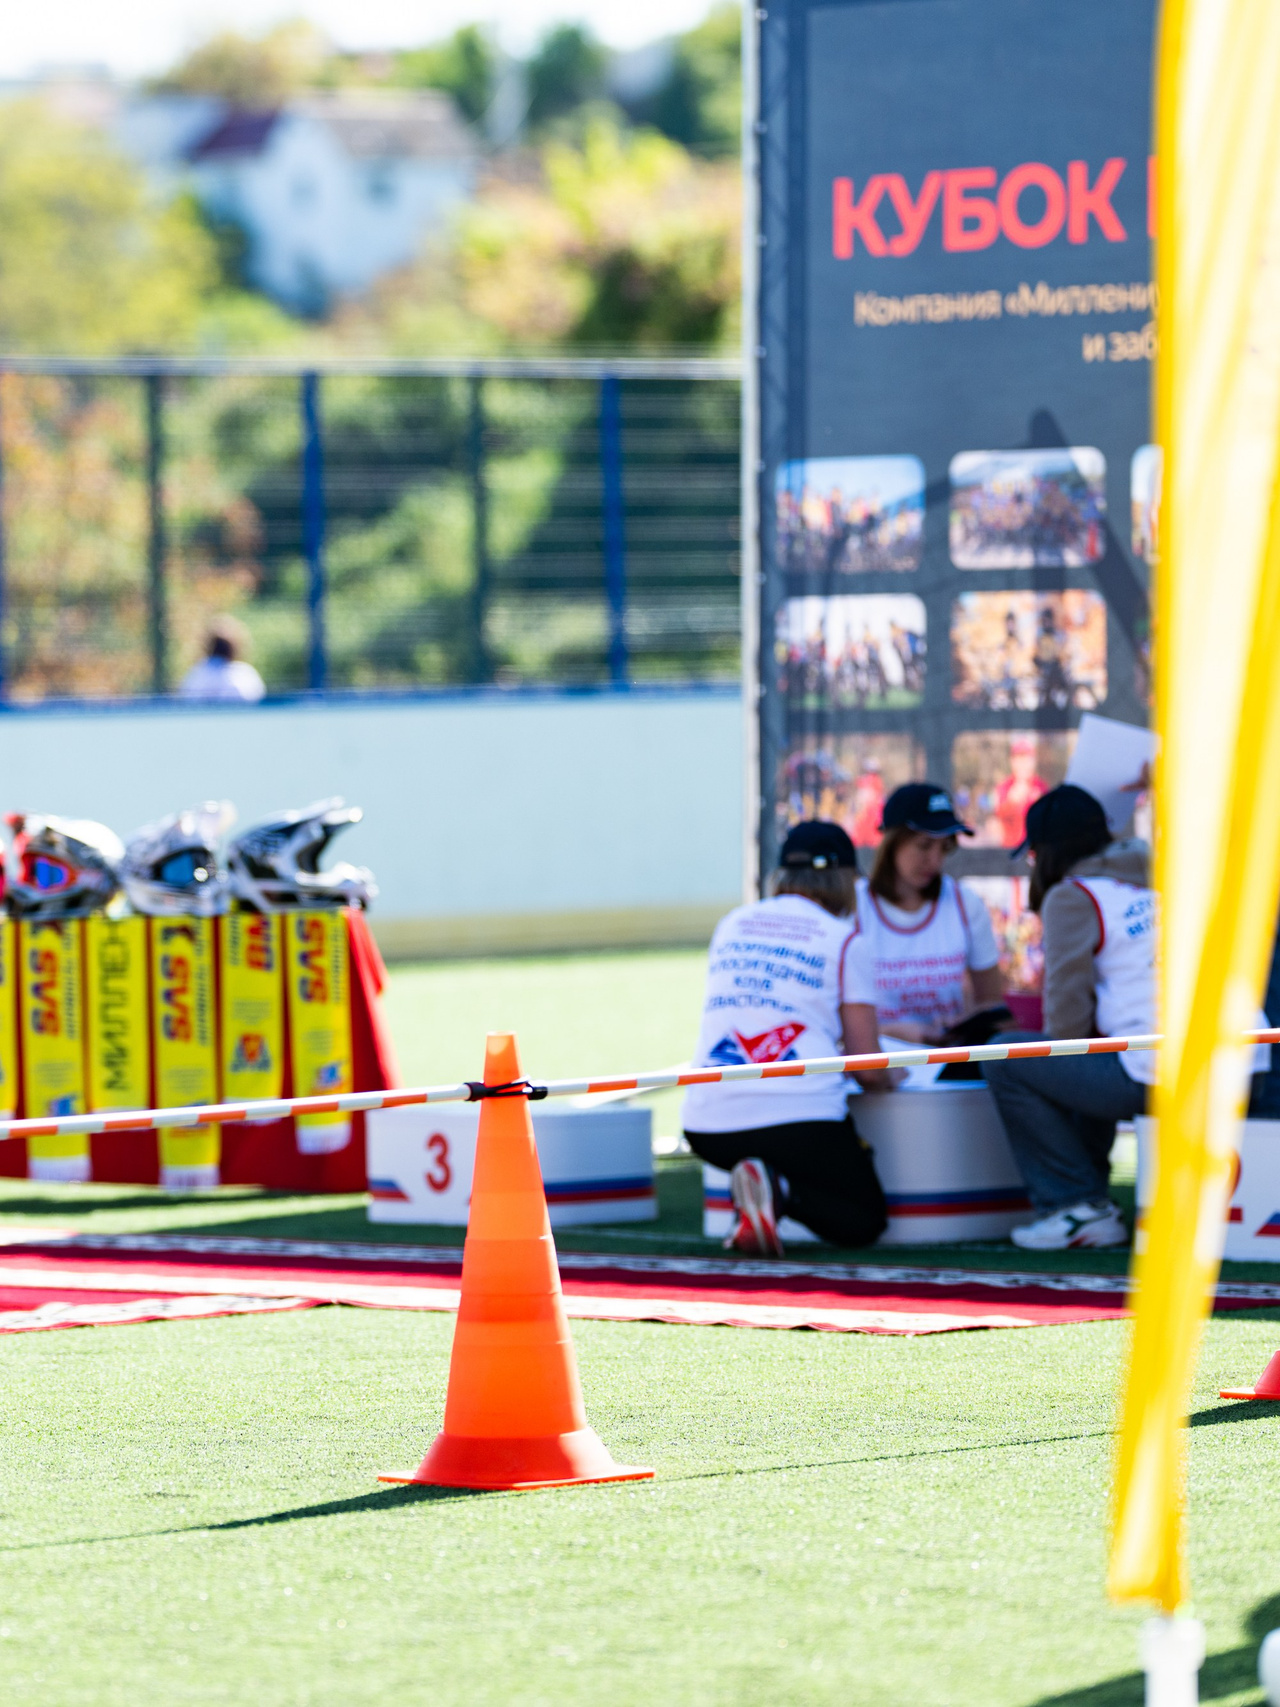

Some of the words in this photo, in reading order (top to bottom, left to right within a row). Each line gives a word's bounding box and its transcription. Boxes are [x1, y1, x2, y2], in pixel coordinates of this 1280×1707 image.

[832, 156, 1128, 260] КУБОК
[853, 289, 1002, 328] Компания
[1082, 332, 1105, 363] и
[29, 949, 59, 1037] SVS
[161, 955, 192, 1043] SVS
[297, 918, 328, 1003] SVS
[426, 1133, 451, 1193] 3
